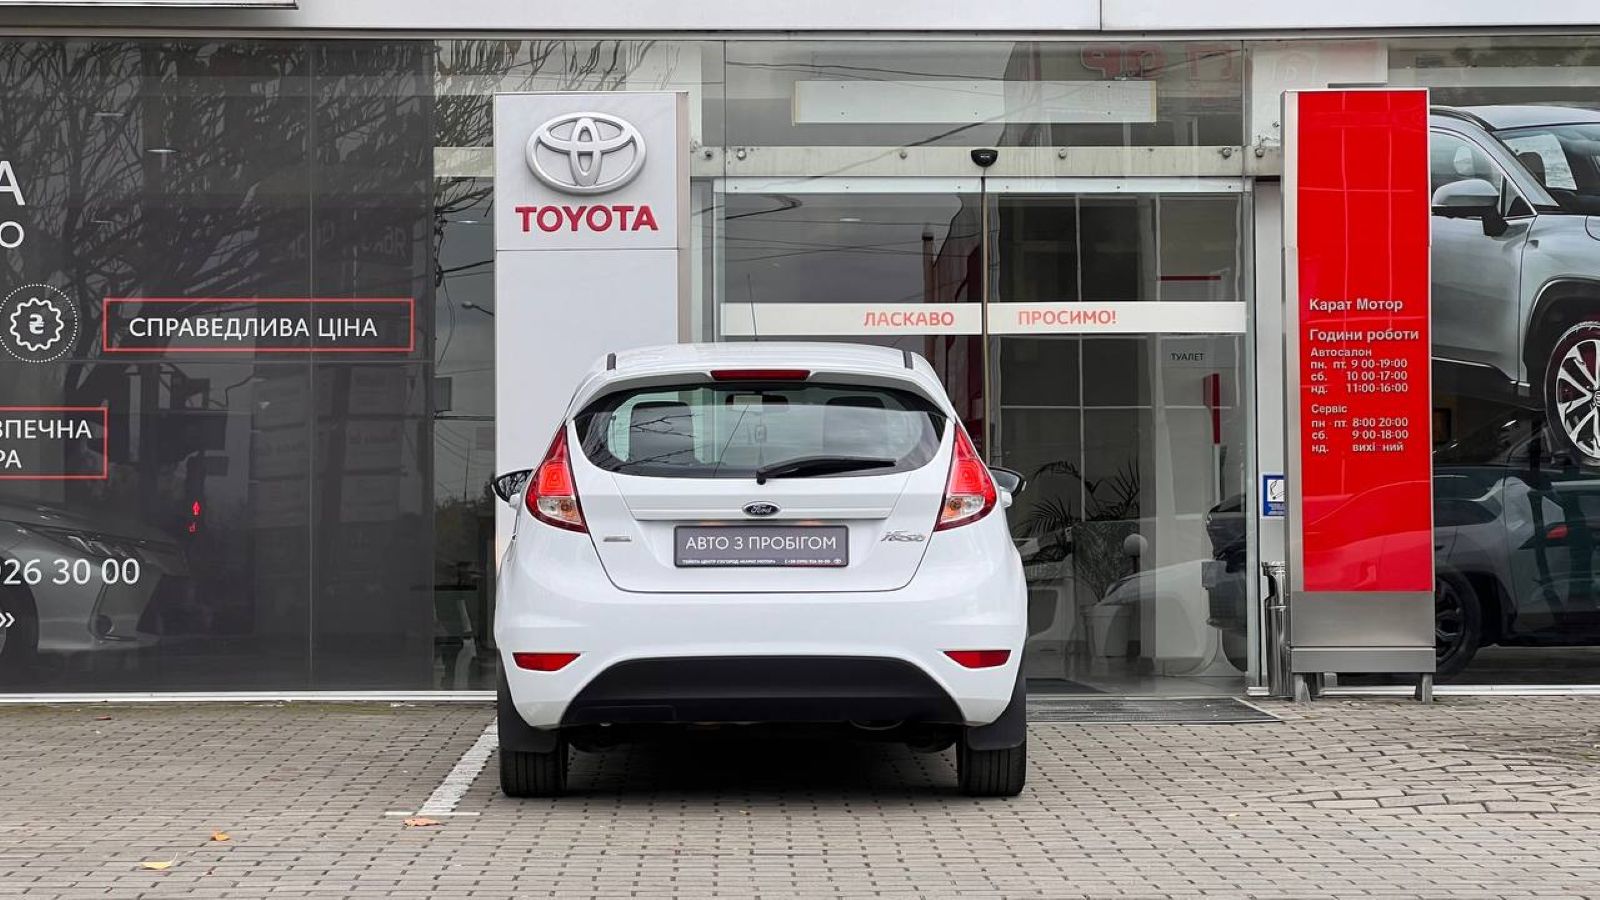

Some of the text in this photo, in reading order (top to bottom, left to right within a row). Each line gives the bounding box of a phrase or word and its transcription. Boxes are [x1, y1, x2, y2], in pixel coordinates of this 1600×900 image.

[515, 204, 659, 233] TOYOTA
[1309, 297, 1404, 314] Карат Мотор
[863, 309, 1117, 328] ЛАСКАВО ПРОСИМО!
[129, 317, 379, 340] СПРАВЕДЛИВА ЦІНА
[1309, 327, 1420, 343] Години роботи
[1170, 352, 1206, 362] ТУАЛЕТ
[1310, 347, 1373, 358] Автосалон
[1346, 382, 1409, 394] 11:00-16:00
[1311, 404, 1348, 416] Сервіс
[685, 536, 730, 551] АВТО
[749, 536, 837, 551] ПРОБІГОМ
[51, 557, 92, 586] 30
[100, 557, 141, 586] 00
